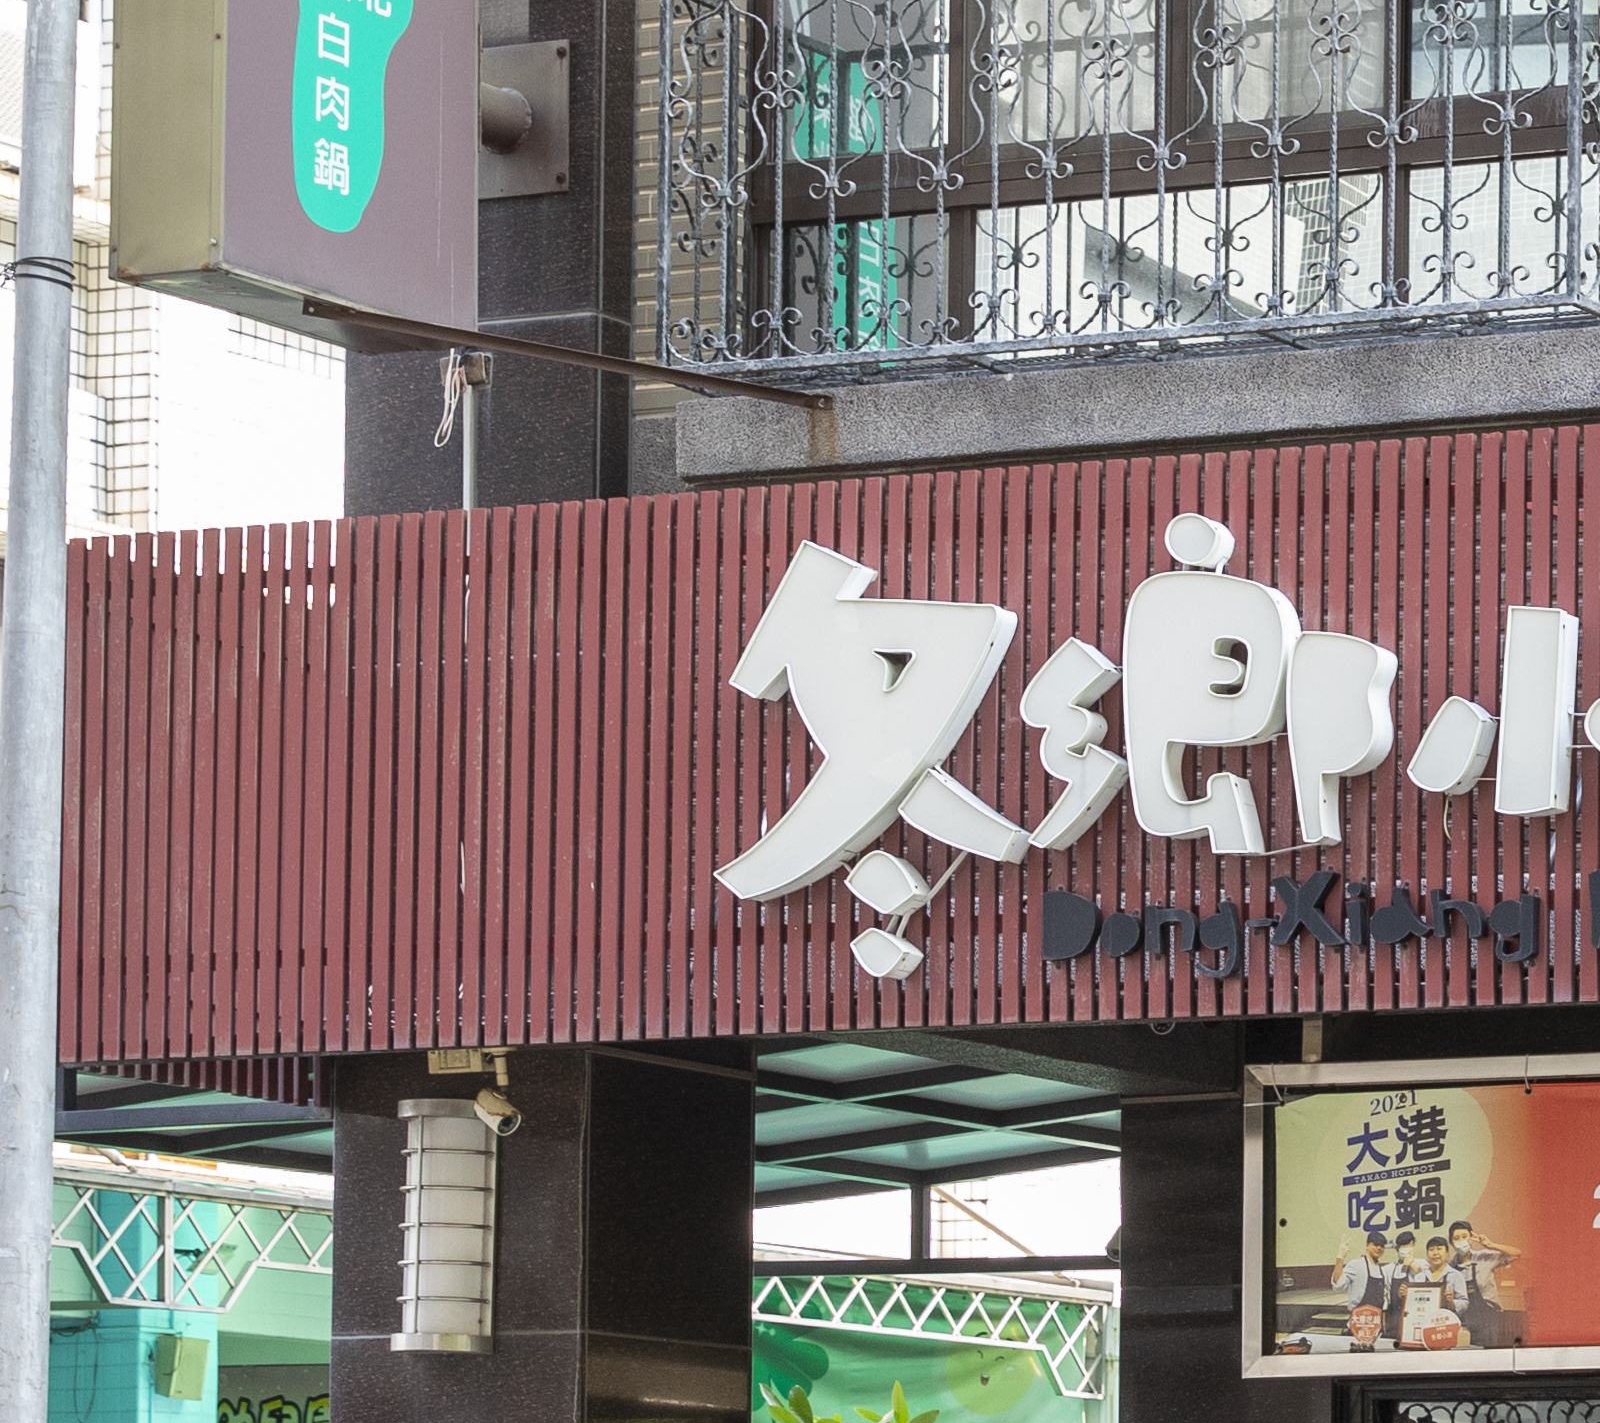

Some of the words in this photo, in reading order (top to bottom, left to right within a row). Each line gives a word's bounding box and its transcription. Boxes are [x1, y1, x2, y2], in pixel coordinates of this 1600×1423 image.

[1041, 871, 1540, 977] Dong-Xiang
[1370, 1089, 1419, 1116] 2021
[1353, 1172, 1388, 1183] TAKAO
[1391, 1163, 1436, 1178] HOTPOT
